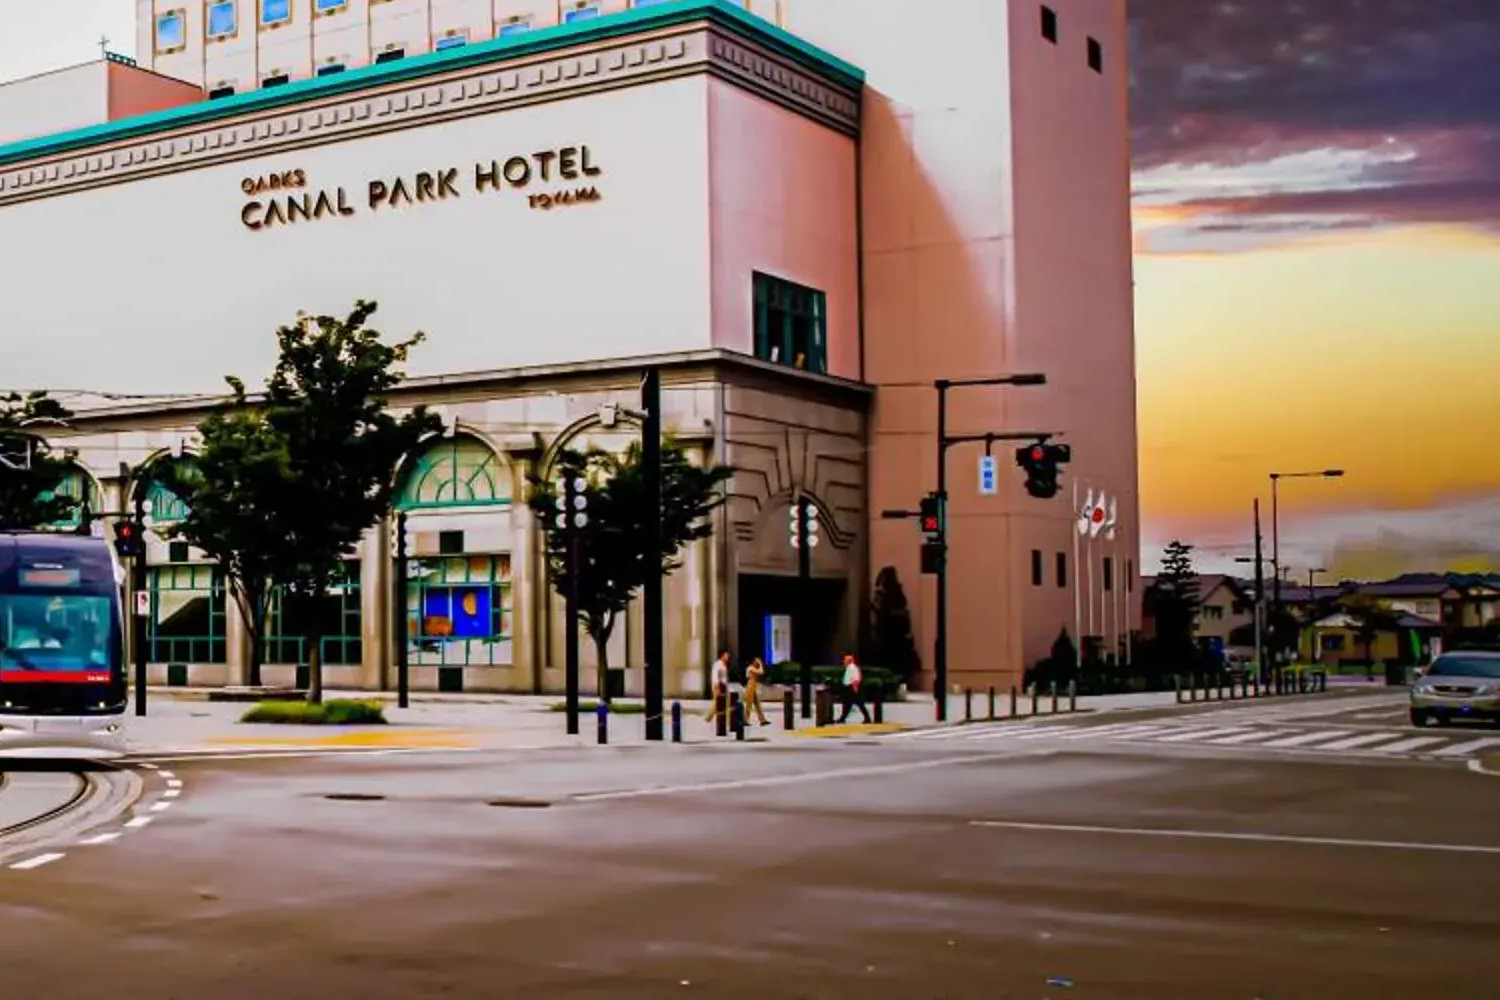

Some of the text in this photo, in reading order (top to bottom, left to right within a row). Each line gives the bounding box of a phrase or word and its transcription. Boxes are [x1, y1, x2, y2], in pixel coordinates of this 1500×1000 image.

[240, 144, 602, 232] CANAL PARK HOTEL
